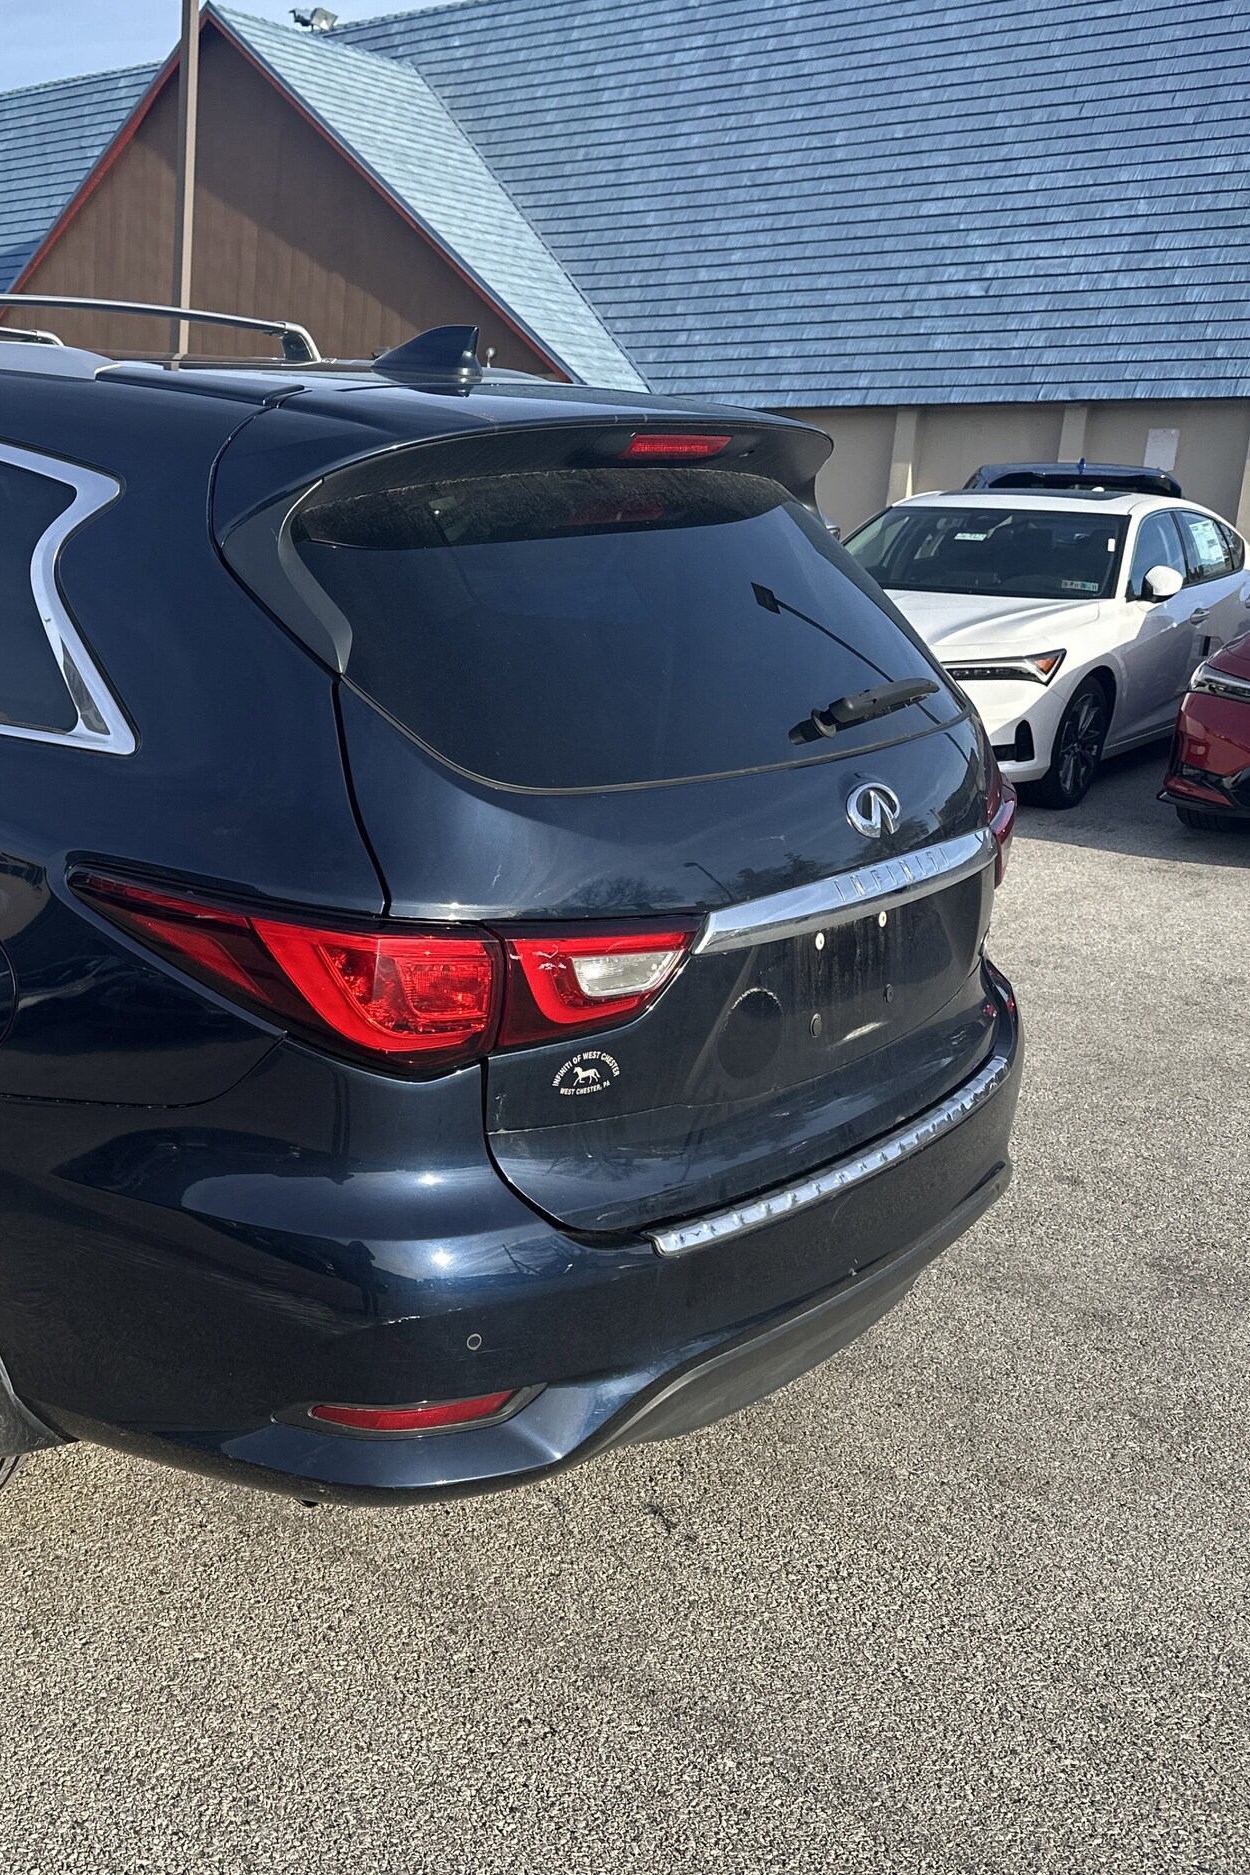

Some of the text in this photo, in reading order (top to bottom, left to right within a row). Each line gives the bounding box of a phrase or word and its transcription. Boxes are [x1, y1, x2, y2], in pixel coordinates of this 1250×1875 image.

[833, 847, 950, 902] INFINITI
[552, 1051, 620, 1087] INFINITI OF WEST CHESTER
[559, 1087, 575, 1095] WEST
